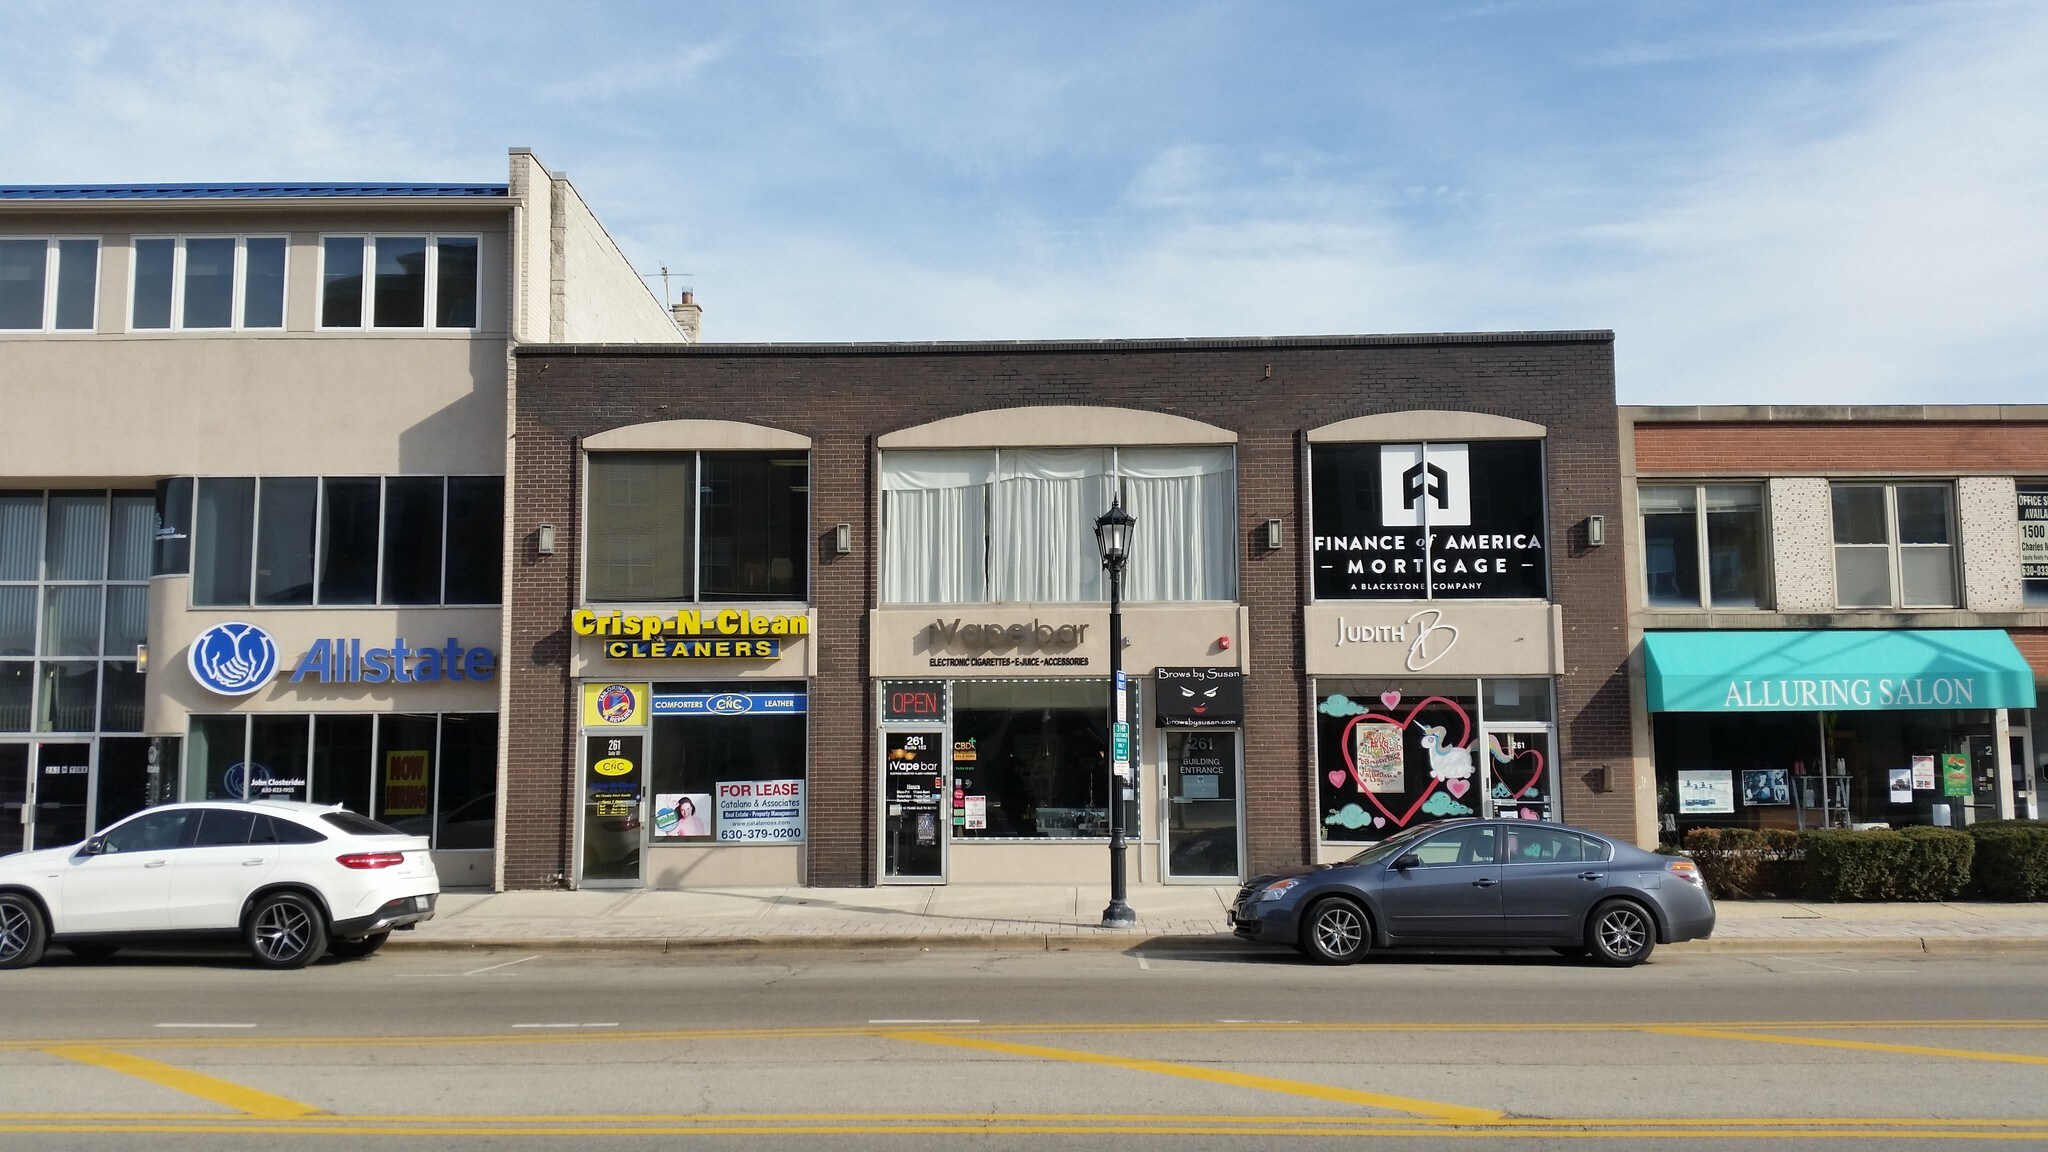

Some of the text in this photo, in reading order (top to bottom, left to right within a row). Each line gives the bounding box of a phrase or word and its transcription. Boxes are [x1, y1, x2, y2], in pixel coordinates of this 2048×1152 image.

[2018, 495, 2042, 506] OFFICE
[2022, 524, 2045, 538] 1500
[1314, 534, 1542, 551] FINANCE of AMERICA
[2021, 542, 2044, 552] Charles
[1347, 558, 1508, 574] MORTGAGE
[1432, 582, 1482, 590] COMPANY
[573, 608, 809, 641] Crisp-N-Clean
[928, 618, 1090, 652] iVape bar
[1406, 608, 1459, 672] B
[609, 640, 772, 658] CLEANERS
[289, 637, 495, 683] Allstate
[929, 658, 970, 667] ELECTRONIC
[970, 658, 1011, 666] CIGARETTES
[1043, 657, 1089, 666] ACCESSORIES
[1158, 668, 1240, 681] Brows by Susan
[598, 685, 627, 702] TAILORING
[1724, 678, 1974, 707] ALLURING SALON
[655, 701, 703, 709] COMFORTERS
[892, 692, 937, 714] OPEN
[1166, 717, 1236, 727] browsbysusan.com
[608, 739, 621, 751] 261
[907, 736, 924, 746] 261
[954, 742, 972, 750] CBD
[1189, 737, 1214, 751] 261
[603, 762, 624, 771] CNC
[889, 761, 938, 773] iVape bar
[1182, 758, 1221, 766] BUILDING
[69, 766, 88, 774] YORK
[389, 756, 425, 781] NOW
[1180, 766, 1224, 774] ENTRANCE
[250, 778, 306, 787] John Closterides
[720, 783, 800, 797] FOR LEASE
[386, 785, 427, 810] HIRING
[720, 799, 800, 810] Catalano & Associates
[751, 810, 771, 818] Property
[770, 810, 797, 818] Management
[721, 827, 802, 840] 630-379-0200
